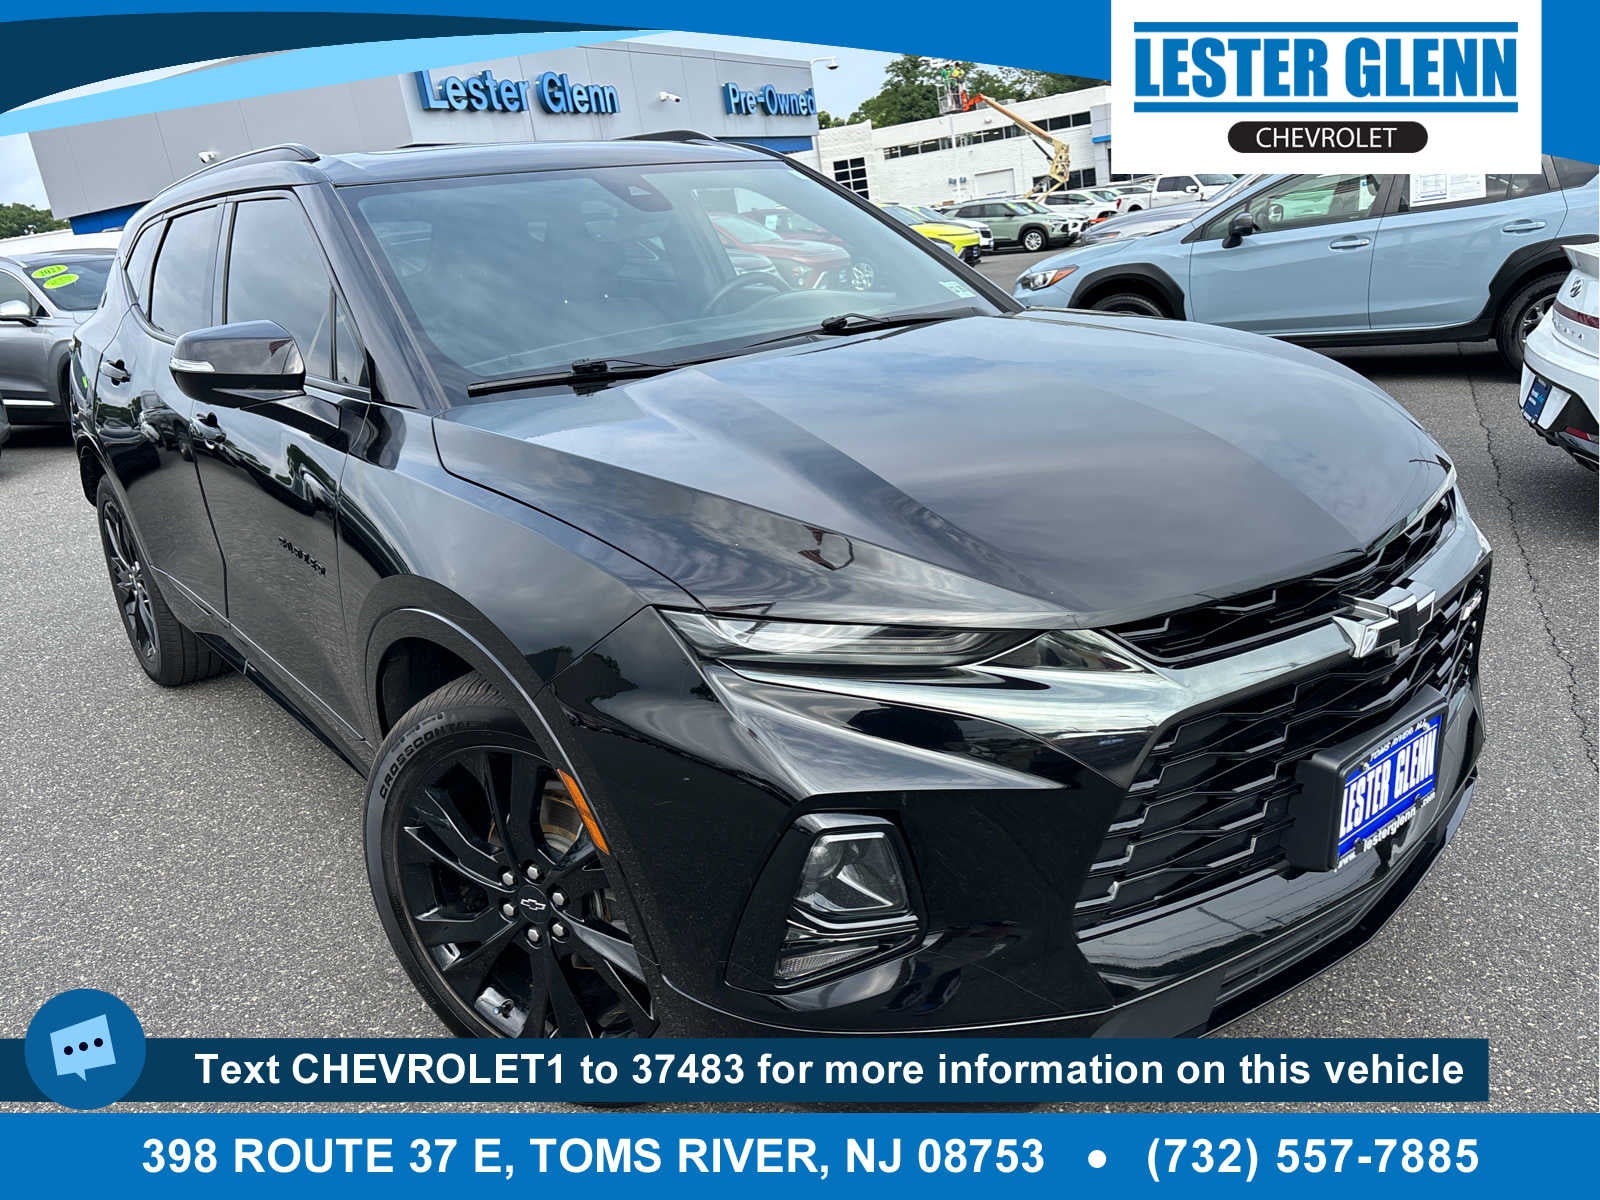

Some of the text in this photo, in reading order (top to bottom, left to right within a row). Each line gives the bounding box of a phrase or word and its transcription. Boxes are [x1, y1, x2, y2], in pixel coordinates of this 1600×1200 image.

[417, 71, 620, 114] Lester Glenn
[724, 82, 817, 116] Pre-Owned
[1339, 728, 1438, 837] LESTER GLENN
